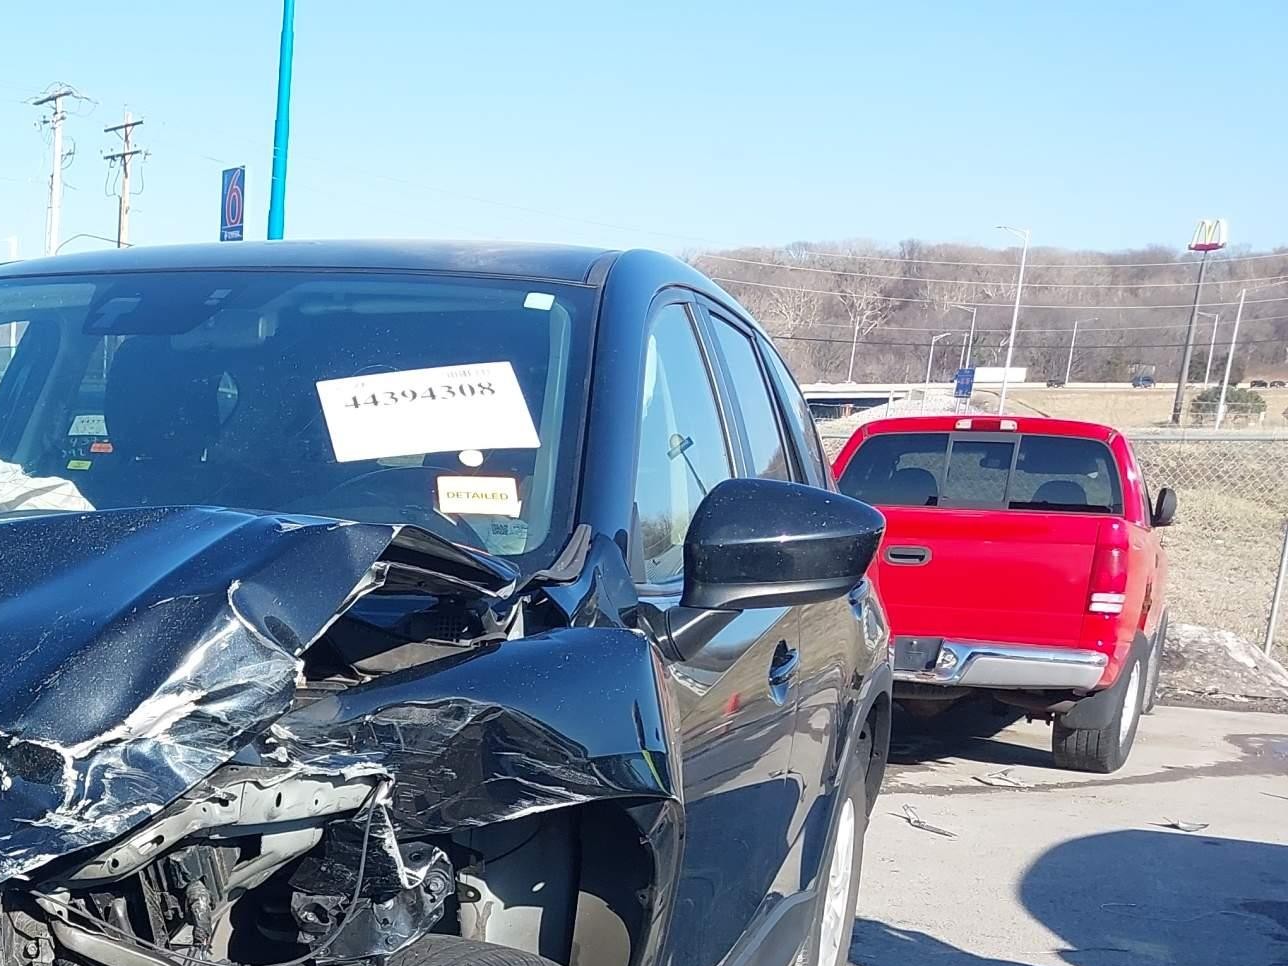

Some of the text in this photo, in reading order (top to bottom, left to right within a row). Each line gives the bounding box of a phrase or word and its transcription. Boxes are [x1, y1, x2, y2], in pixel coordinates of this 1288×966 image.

[225, 169, 243, 226] 6
[344, 381, 496, 409] 44394308
[446, 491, 509, 500] DETAILED
